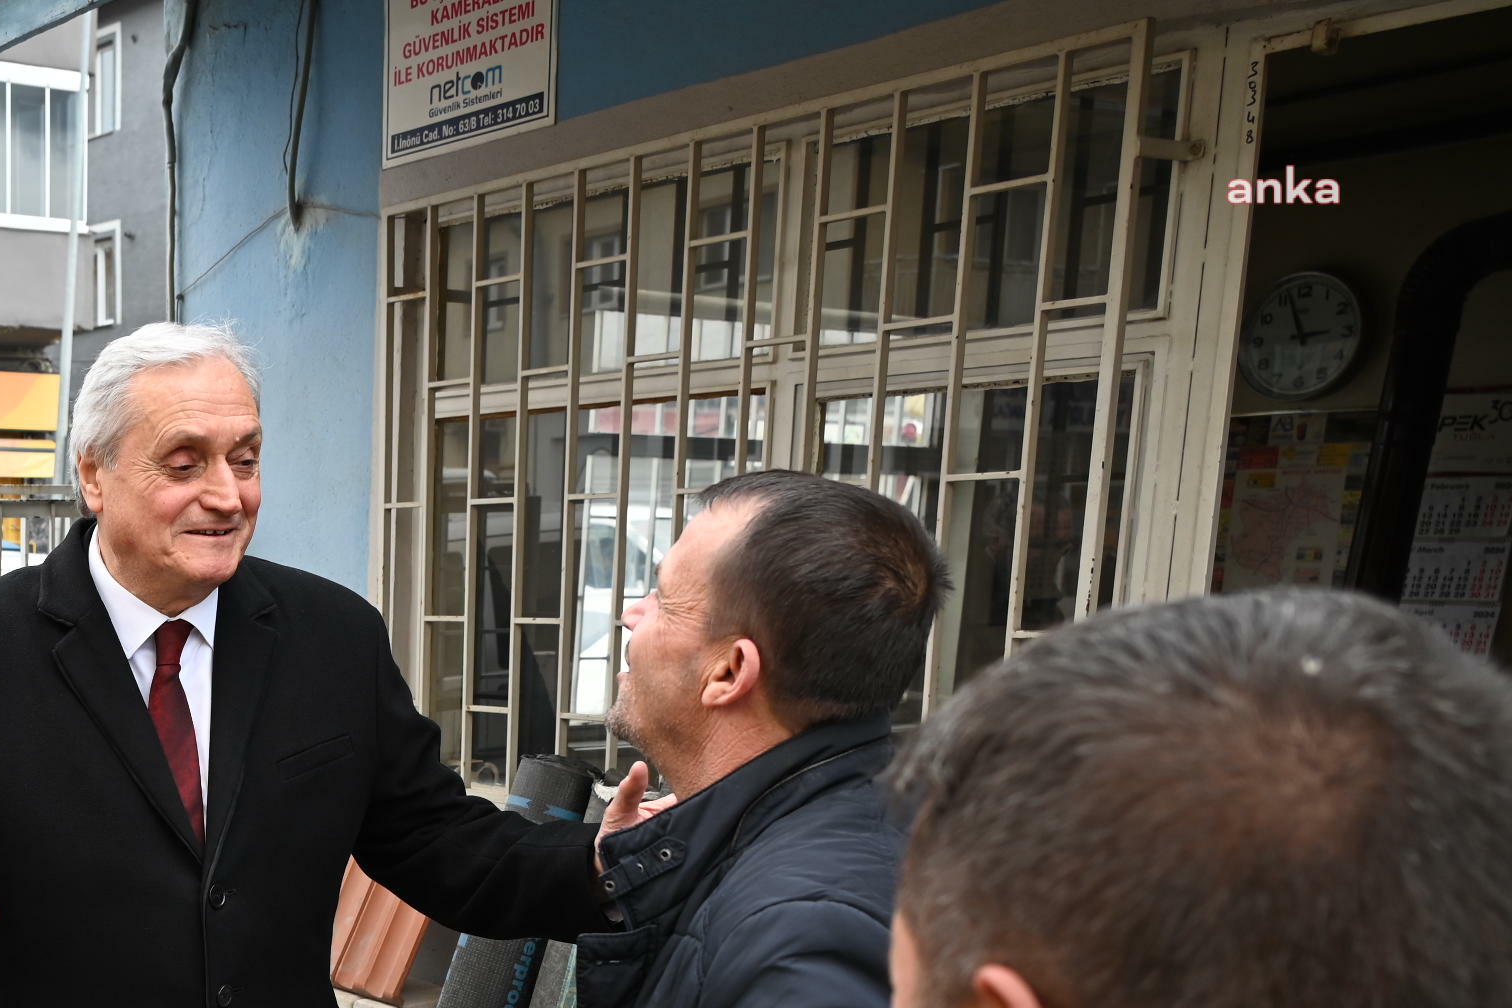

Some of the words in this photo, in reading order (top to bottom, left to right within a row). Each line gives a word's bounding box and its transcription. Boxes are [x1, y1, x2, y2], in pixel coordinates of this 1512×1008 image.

[393, 66, 412, 87] İLE
[416, 23, 545, 80] KORUNMAKTADIR
[402, 20, 472, 60] GÜVENLİK
[428, 102, 462, 119] Güvenlik
[462, 88, 503, 108] Sistemleri
[429, 64, 503, 105] netcom
[422, 127, 441, 143] Cad.
[442, 124, 457, 139] No:
[458, 119, 477, 133] 63/B
[479, 113, 495, 128] Tel:
[497, 107, 513, 122] 314
[516, 102, 527, 117] 70
[528, 98, 540, 113] 03
